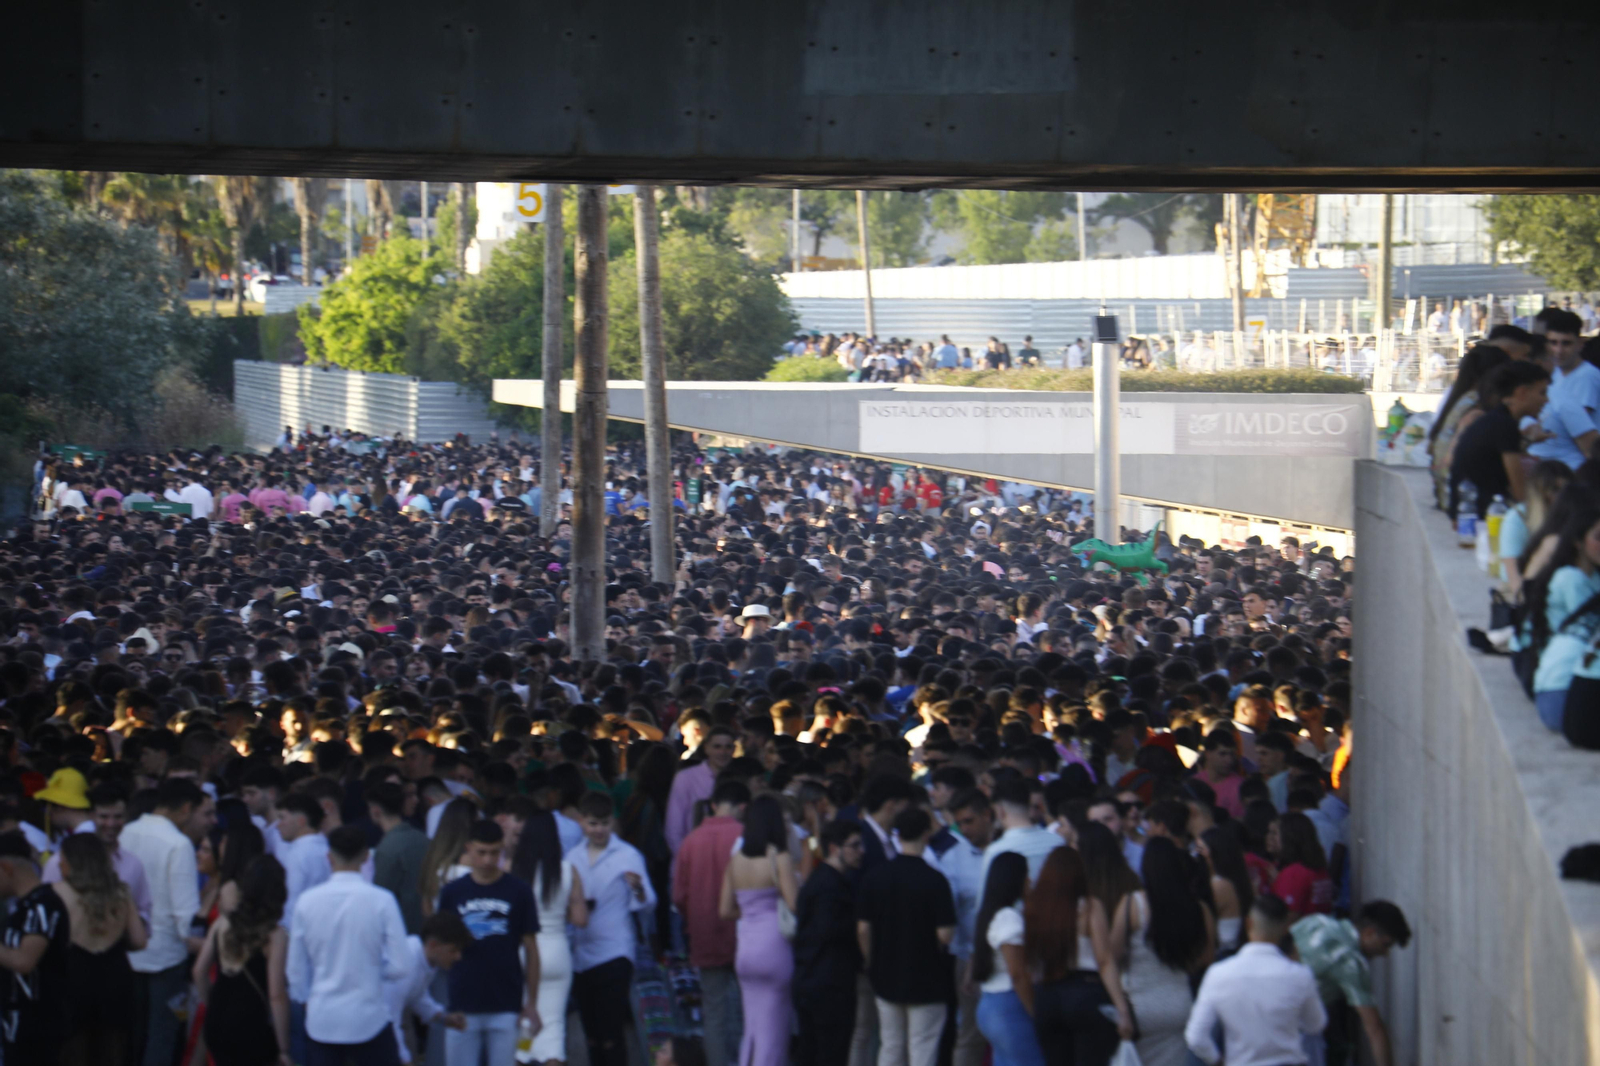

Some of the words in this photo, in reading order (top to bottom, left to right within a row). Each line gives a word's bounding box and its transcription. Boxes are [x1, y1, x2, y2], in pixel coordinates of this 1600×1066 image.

[516, 183, 543, 217] 5
[1249, 320, 1264, 338] 7
[866, 404, 968, 418] INSTALACIÓN
[973, 405, 1055, 418] DEPORTIVA
[1225, 412, 1348, 435] IMDECO
